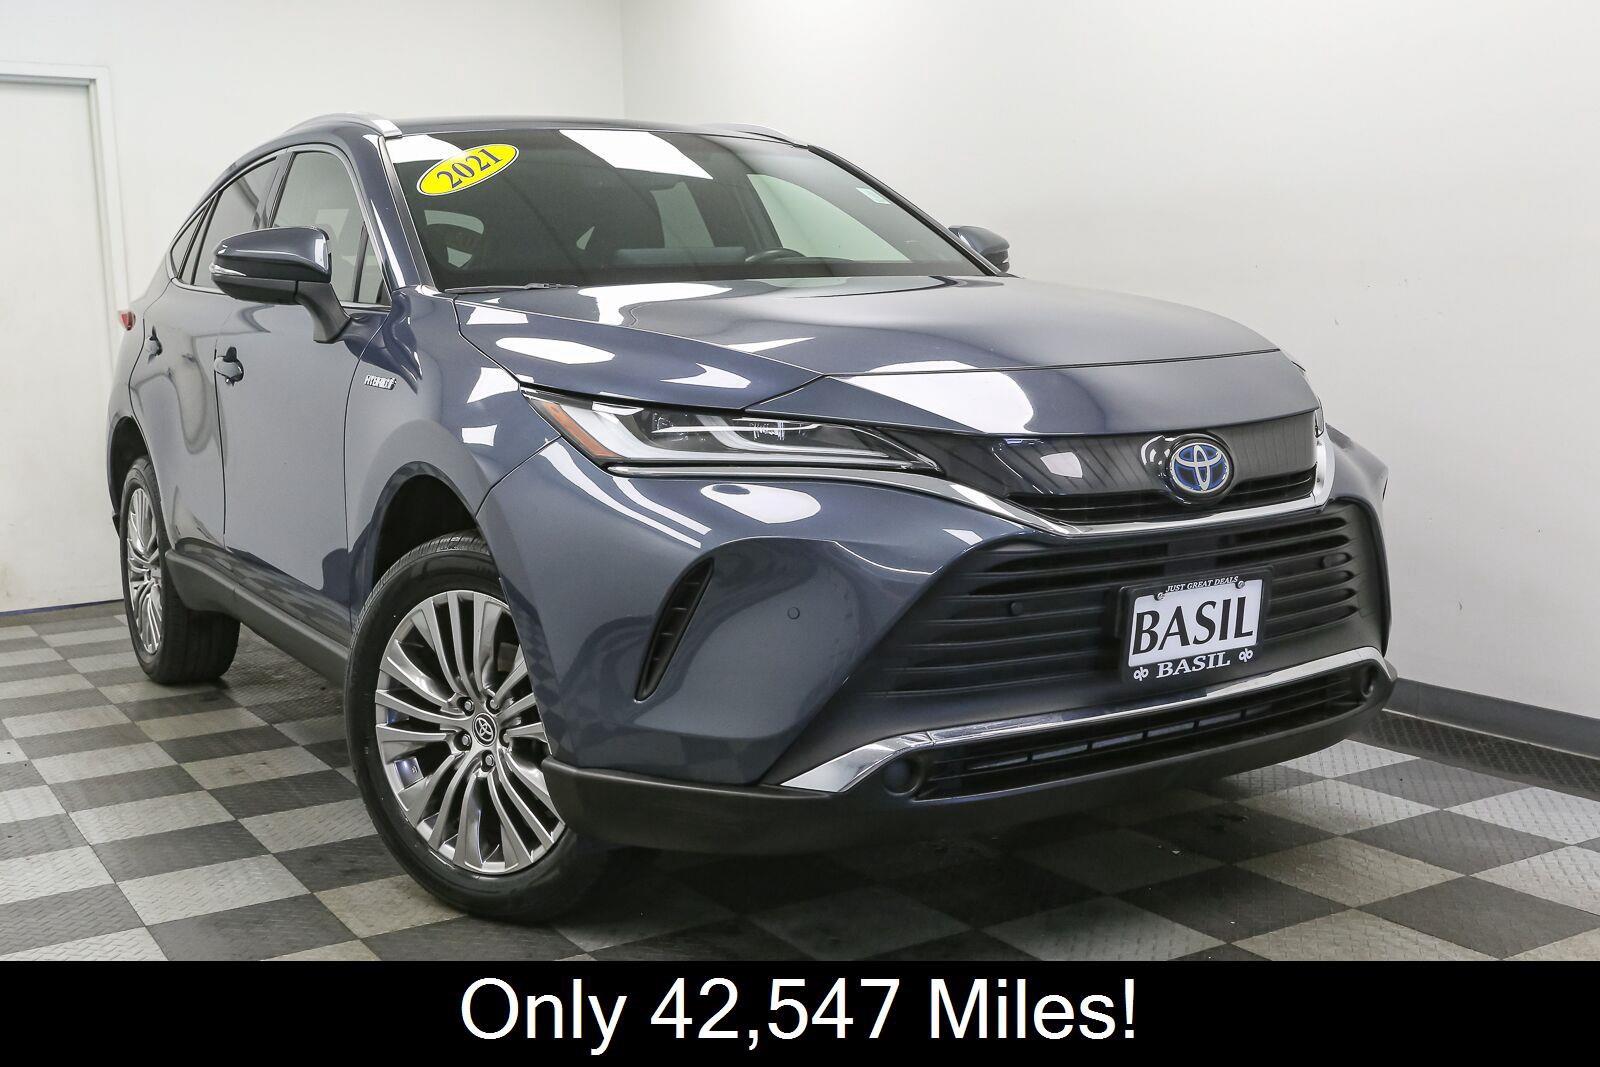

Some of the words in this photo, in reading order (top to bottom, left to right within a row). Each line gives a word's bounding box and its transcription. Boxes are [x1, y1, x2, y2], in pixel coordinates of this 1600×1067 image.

[437, 148, 503, 188] 2021
[1165, 583, 1186, 593] JUST
[1186, 579, 1214, 589] GREAT
[1214, 575, 1239, 585] DEALS
[1132, 596, 1254, 656] BASIL
[1156, 652, 1231, 679] BASIL
